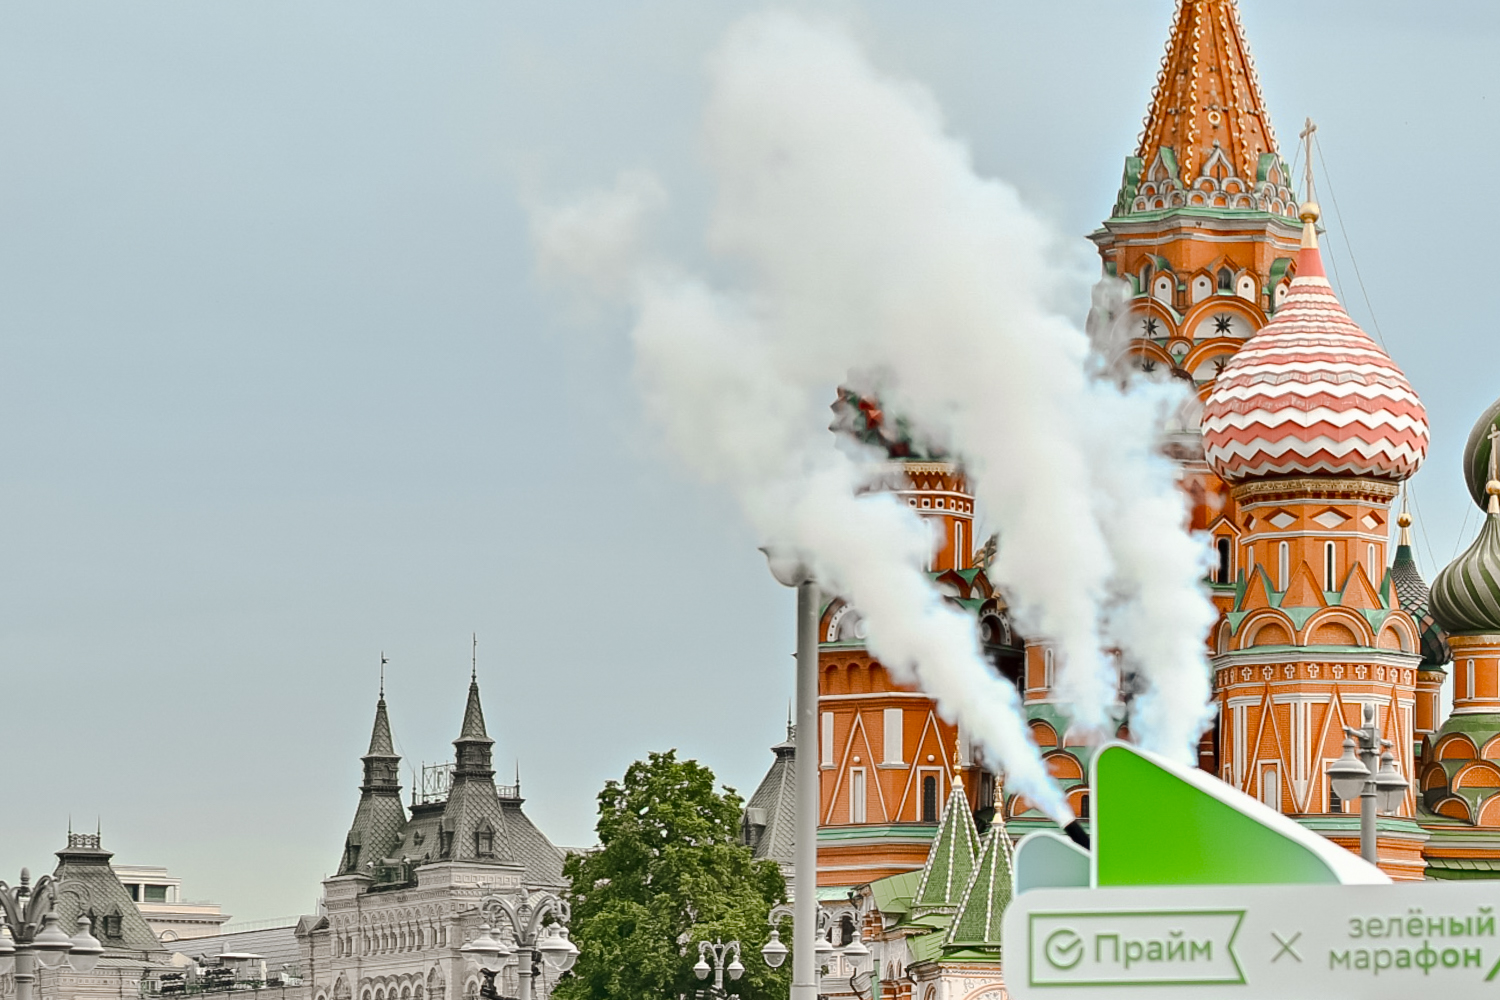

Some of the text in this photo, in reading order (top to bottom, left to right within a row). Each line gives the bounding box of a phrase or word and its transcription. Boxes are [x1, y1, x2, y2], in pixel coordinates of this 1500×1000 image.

[1348, 906, 1496, 938] зелёный
[1095, 930, 1213, 969] Прайм
[1329, 940, 1482, 975] марафон
